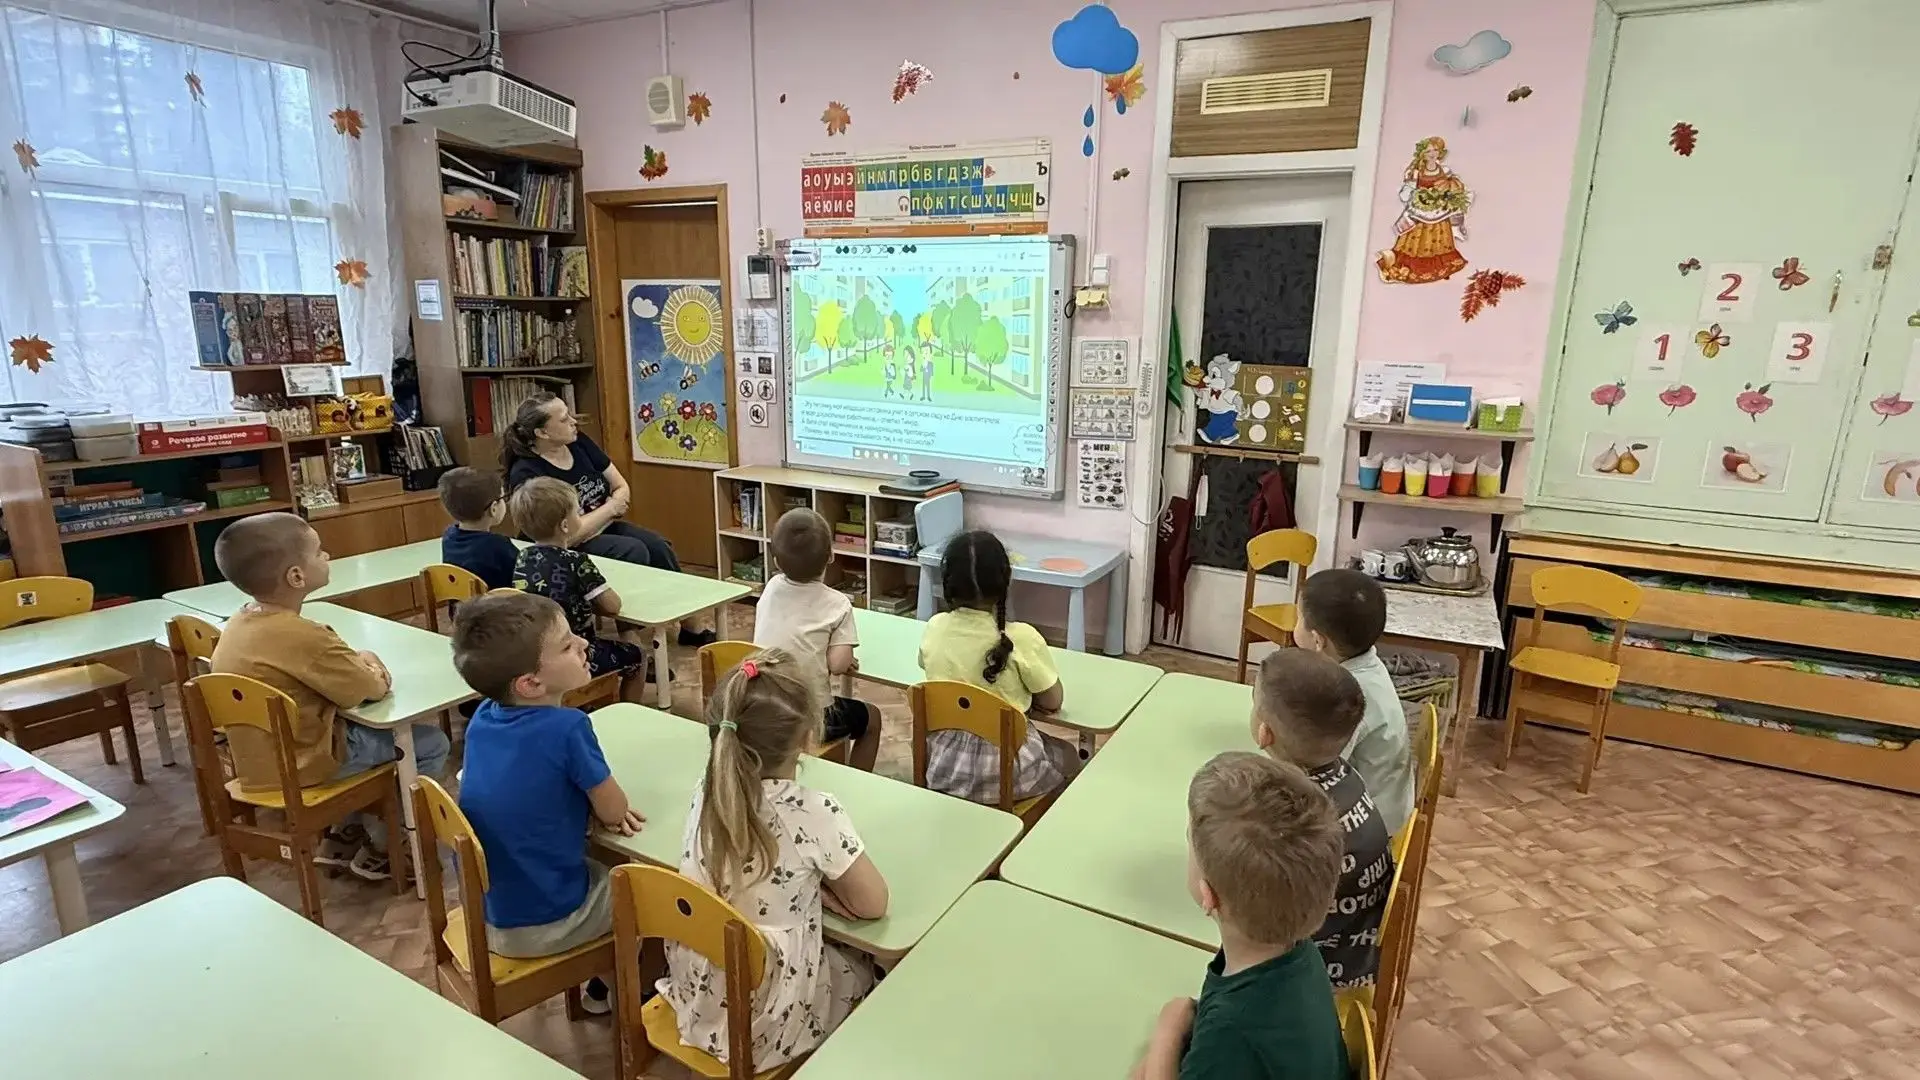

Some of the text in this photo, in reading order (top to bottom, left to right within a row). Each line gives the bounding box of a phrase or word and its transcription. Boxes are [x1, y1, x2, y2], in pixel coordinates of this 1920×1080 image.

[1716, 273, 1743, 301] 2
[1654, 334, 1670, 361] 1
[1785, 333, 1813, 361] 3
[168, 436, 206, 445] Речевое
[207, 431, 247, 443] развитие
[1339, 801, 1369, 832] THE
